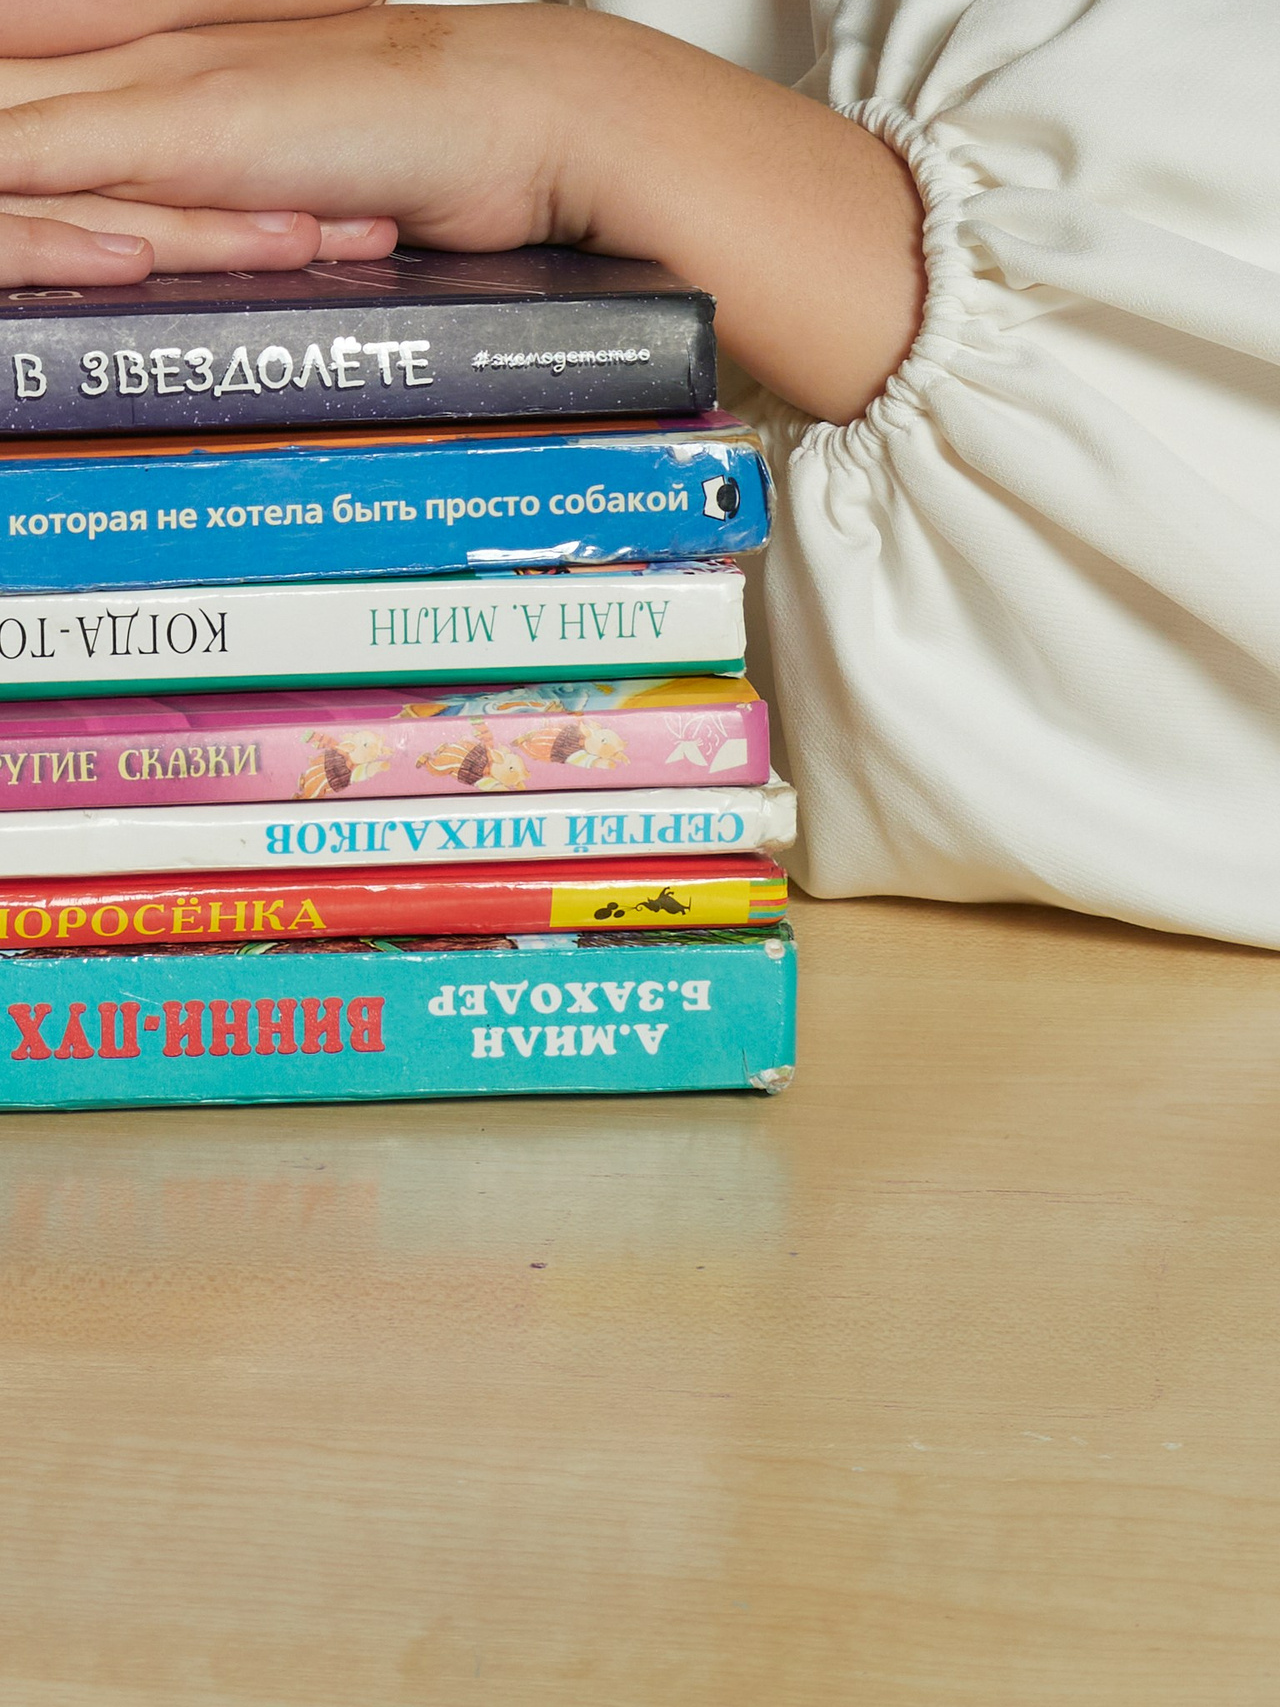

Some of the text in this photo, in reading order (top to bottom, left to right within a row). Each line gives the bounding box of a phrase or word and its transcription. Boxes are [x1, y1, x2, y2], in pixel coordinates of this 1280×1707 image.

[13, 353, 48, 398] В
[80, 336, 434, 397] ЗВЕЗДОЛЁТЕ
[8, 509, 148, 541] которая
[156, 507, 198, 531] не
[206, 500, 323, 528] хотела
[332, 493, 418, 524] быть
[425, 494, 541, 526] просто
[548, 483, 689, 516] собакой
[369, 600, 671, 646] АЛАН А. МИЛН
[117, 744, 258, 781] СКАЗКИ
[265, 811, 746, 855] СЕРГЕЙ МИХАЛКОВ
[427, 979, 712, 1017] Б.ЗАХОДЕР
[7, 996, 386, 1060] ВИННИ-ПУХ
[470, 1023, 670, 1059] А.МИЛН
